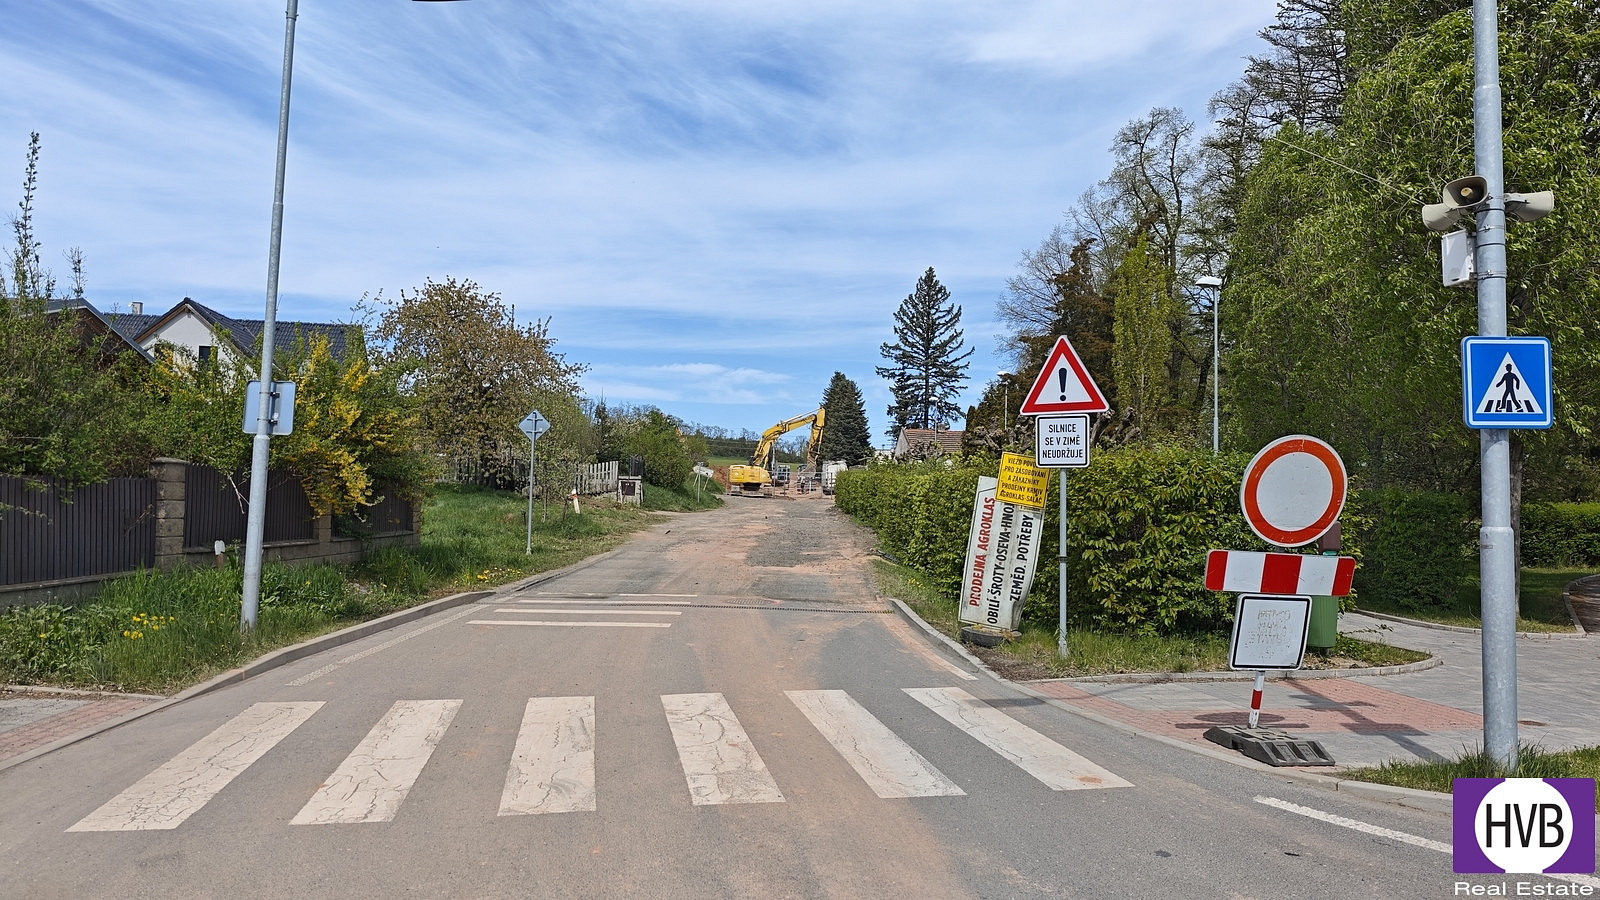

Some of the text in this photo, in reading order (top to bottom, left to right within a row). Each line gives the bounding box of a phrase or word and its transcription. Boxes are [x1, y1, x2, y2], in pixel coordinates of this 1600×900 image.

[1045, 434, 1080, 446] SE V ZIMĚ
[1048, 424, 1076, 432] SILNICE
[1042, 448, 1084, 458] NEUDRŽUJE
[1001, 503, 1015, 528] HNOJ
[1016, 514, 1034, 561] POTŘEBY
[969, 497, 995, 607] PRODEJNA AGROKLAS
[1010, 565, 1026, 601] ZEMĚD.
